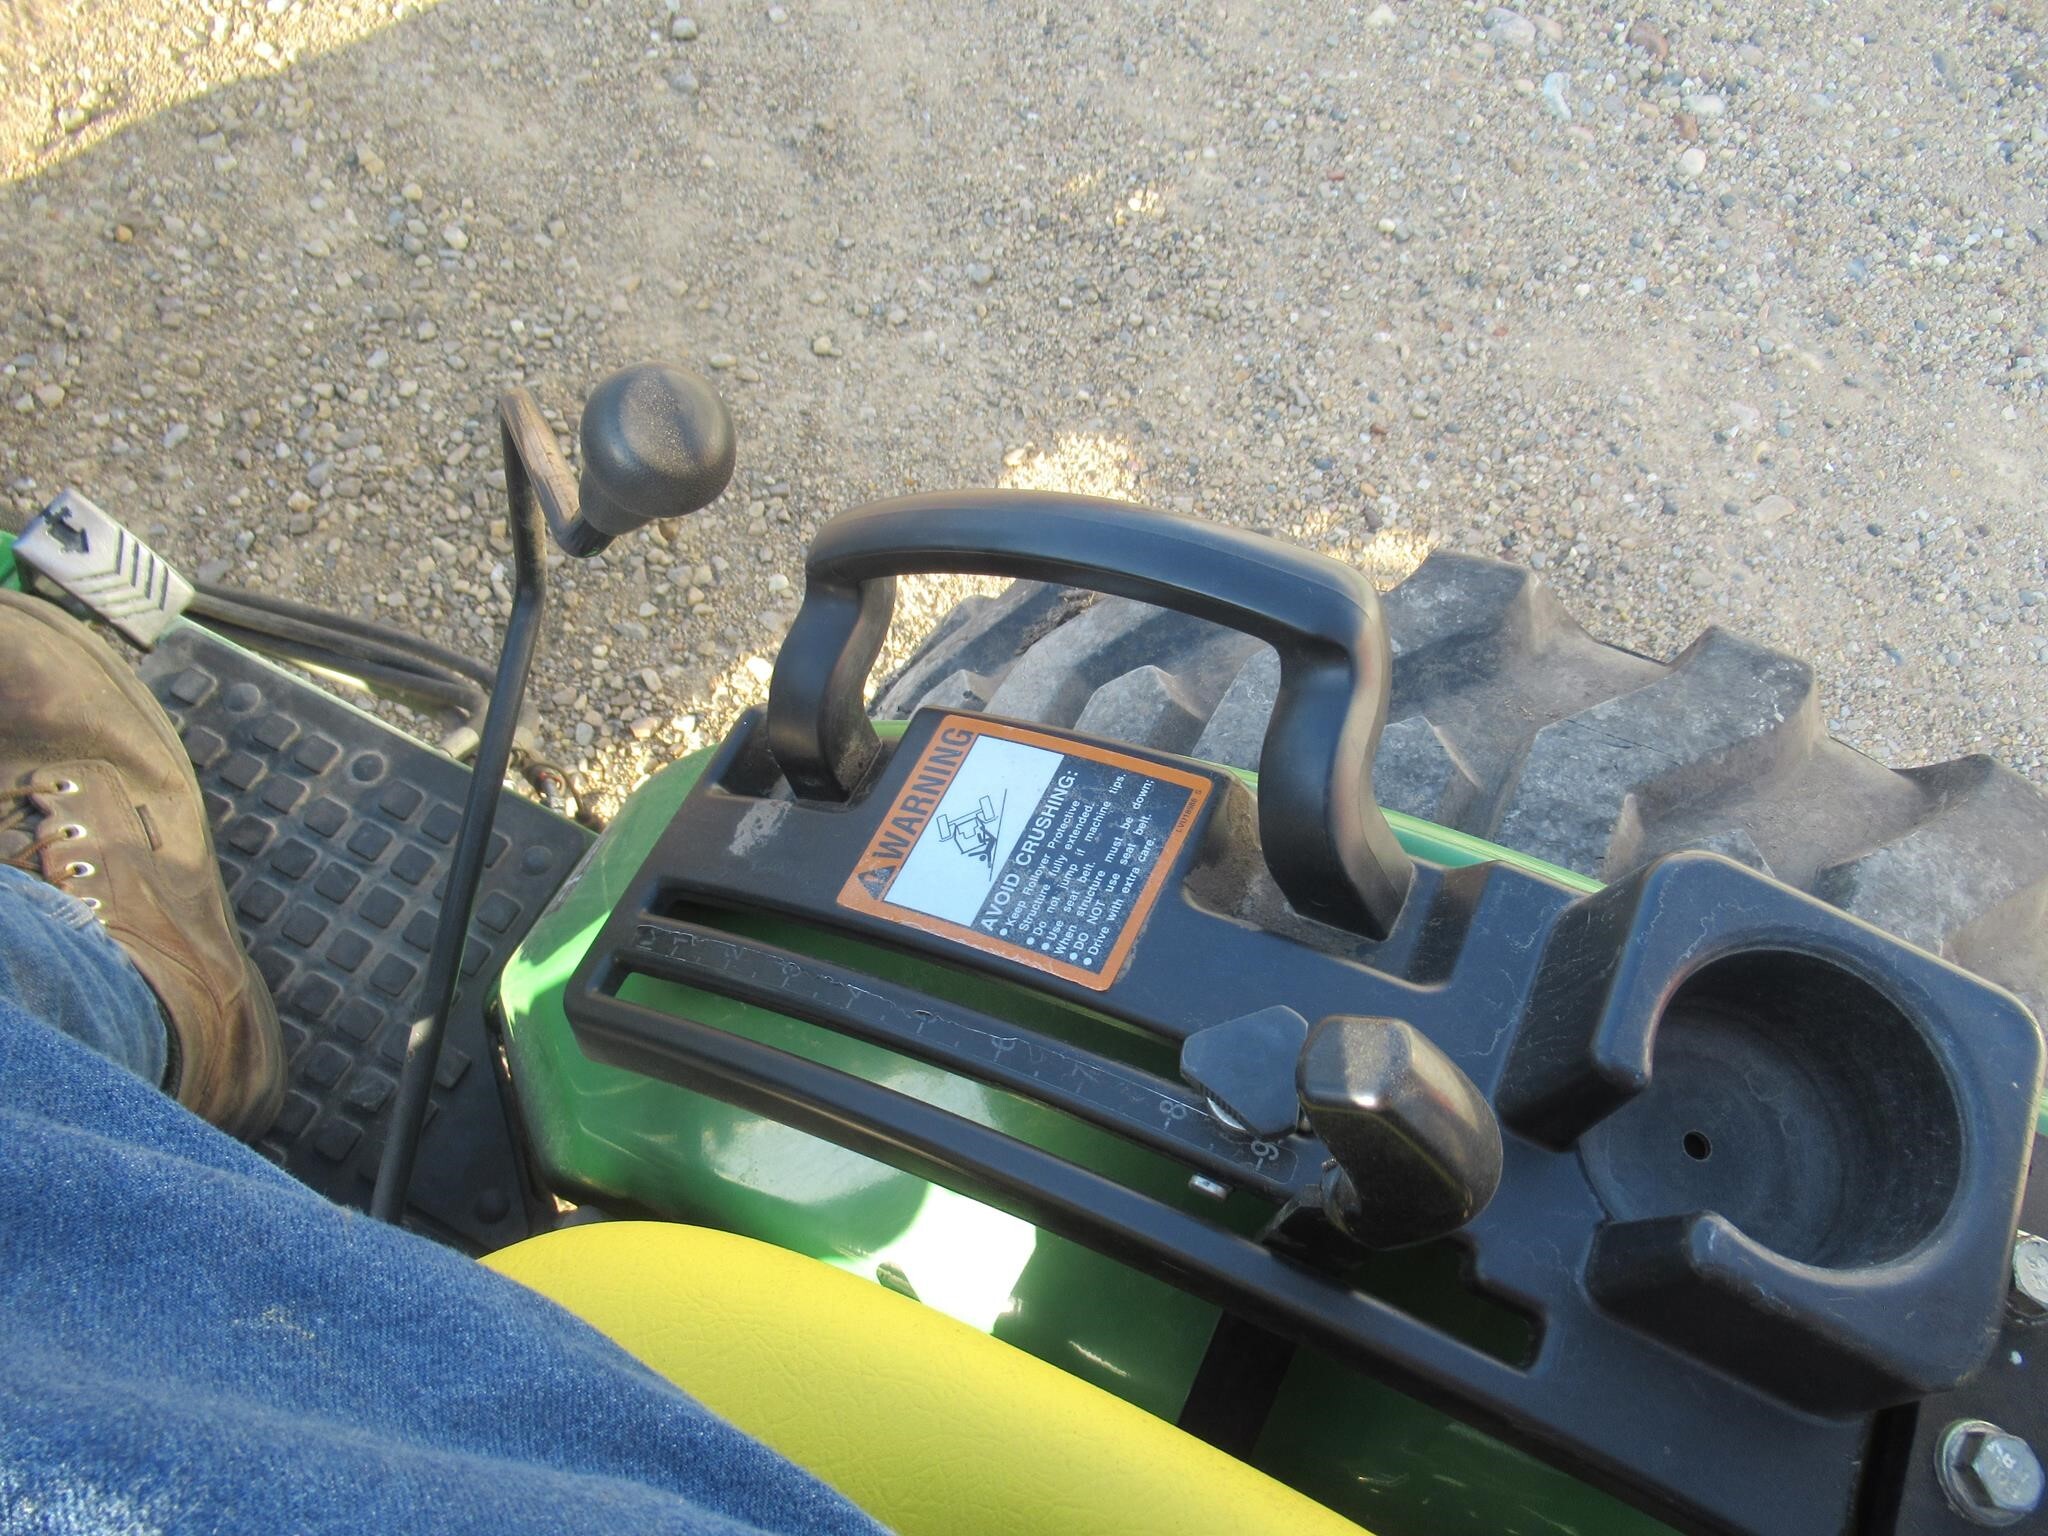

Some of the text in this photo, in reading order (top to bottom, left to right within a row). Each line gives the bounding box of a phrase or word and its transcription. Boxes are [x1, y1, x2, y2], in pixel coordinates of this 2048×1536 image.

[871, 727, 974, 864] WARNING
[980, 770, 1078, 931] AVOID CRUSHING:
[1032, 774, 1126, 935] Do not jump if machine tips.
[1004, 800, 1080, 926] Keep Rollover Protective
[1018, 803, 1094, 931] Structure fully extended.
[1045, 862, 1095, 940] Use seat belt.
[1053, 924, 1077, 953] When
[1076, 870, 1105, 916] structure
[1104, 836, 1123, 862] must
[1119, 816, 1133, 829] be
[1072, 814, 1151, 950] DO NOT use seat belt.
[1087, 837, 1156, 955] Drive with extra care.
[1159, 1099, 1188, 1120] 8
